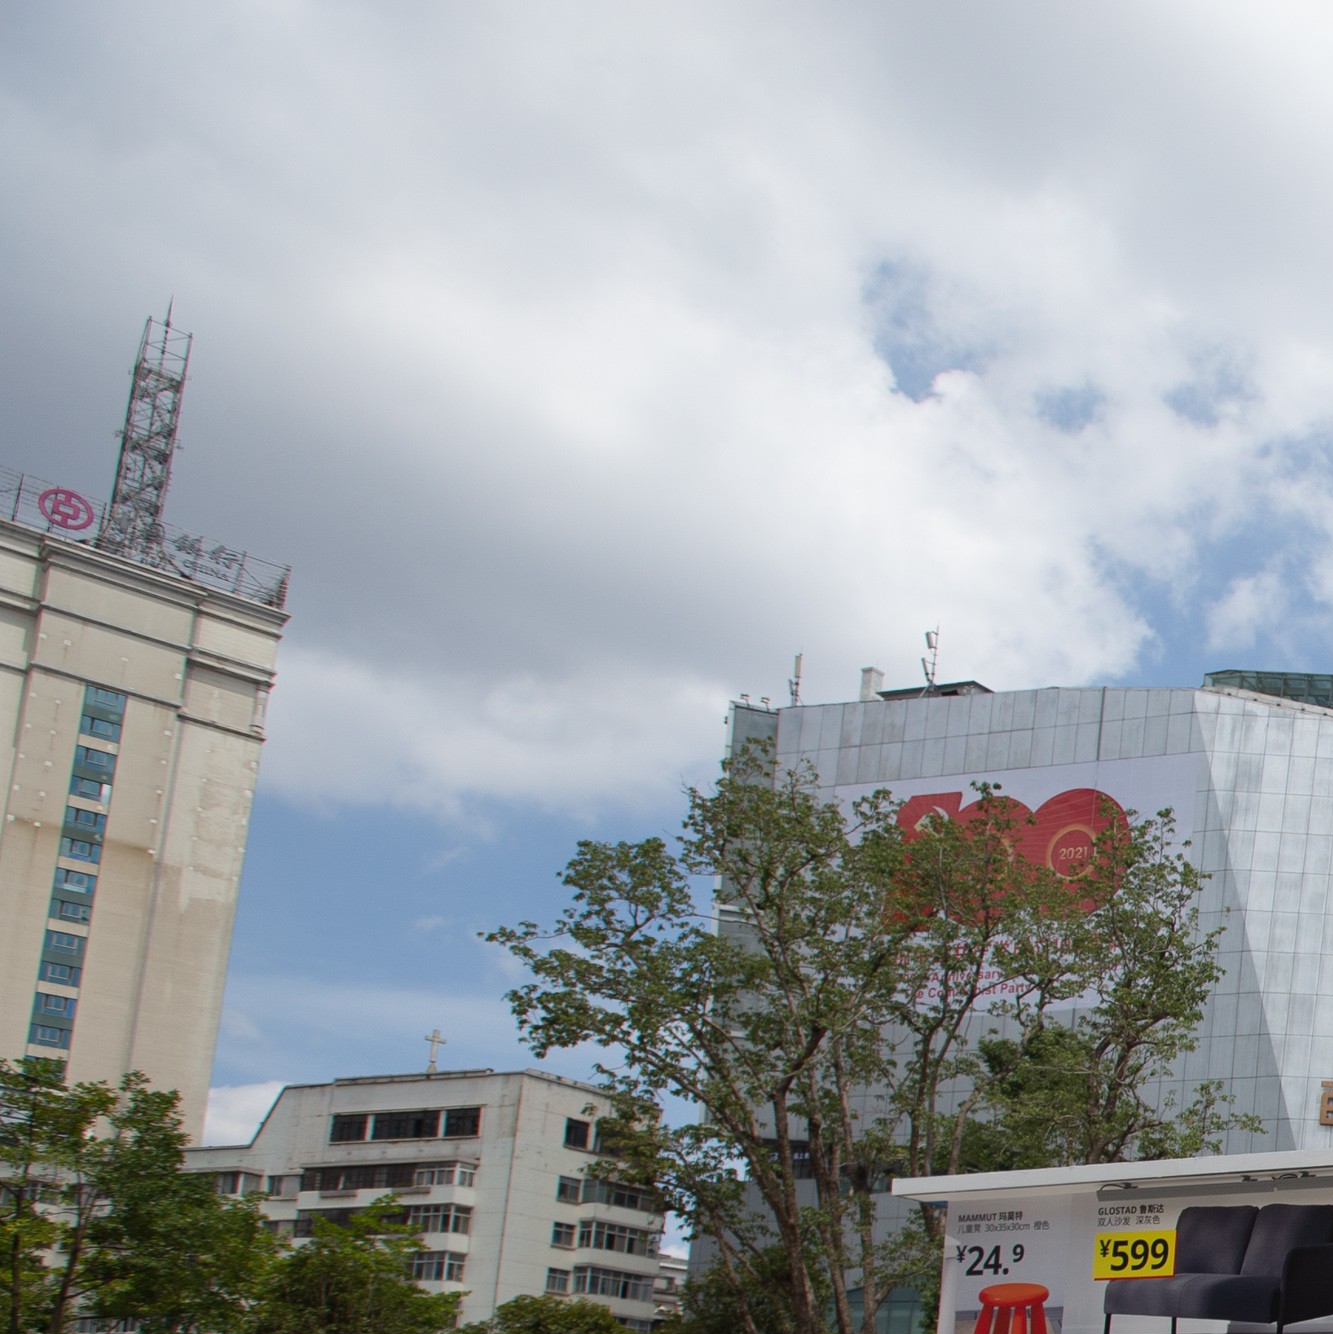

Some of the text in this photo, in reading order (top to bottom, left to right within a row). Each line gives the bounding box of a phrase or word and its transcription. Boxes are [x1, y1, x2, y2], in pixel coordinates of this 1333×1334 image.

[1059, 847, 1088, 860] 2021
[1098, 1203, 1165, 1216] GLOSTAD 鲁斯达
[958, 1213, 997, 1223] MAMMUT
[1097, 1214, 1161, 1228] 双人沙发 深灰色
[1033, 1220, 1050, 1231] 橙色
[1100, 1238, 1169, 1271] ¥599
